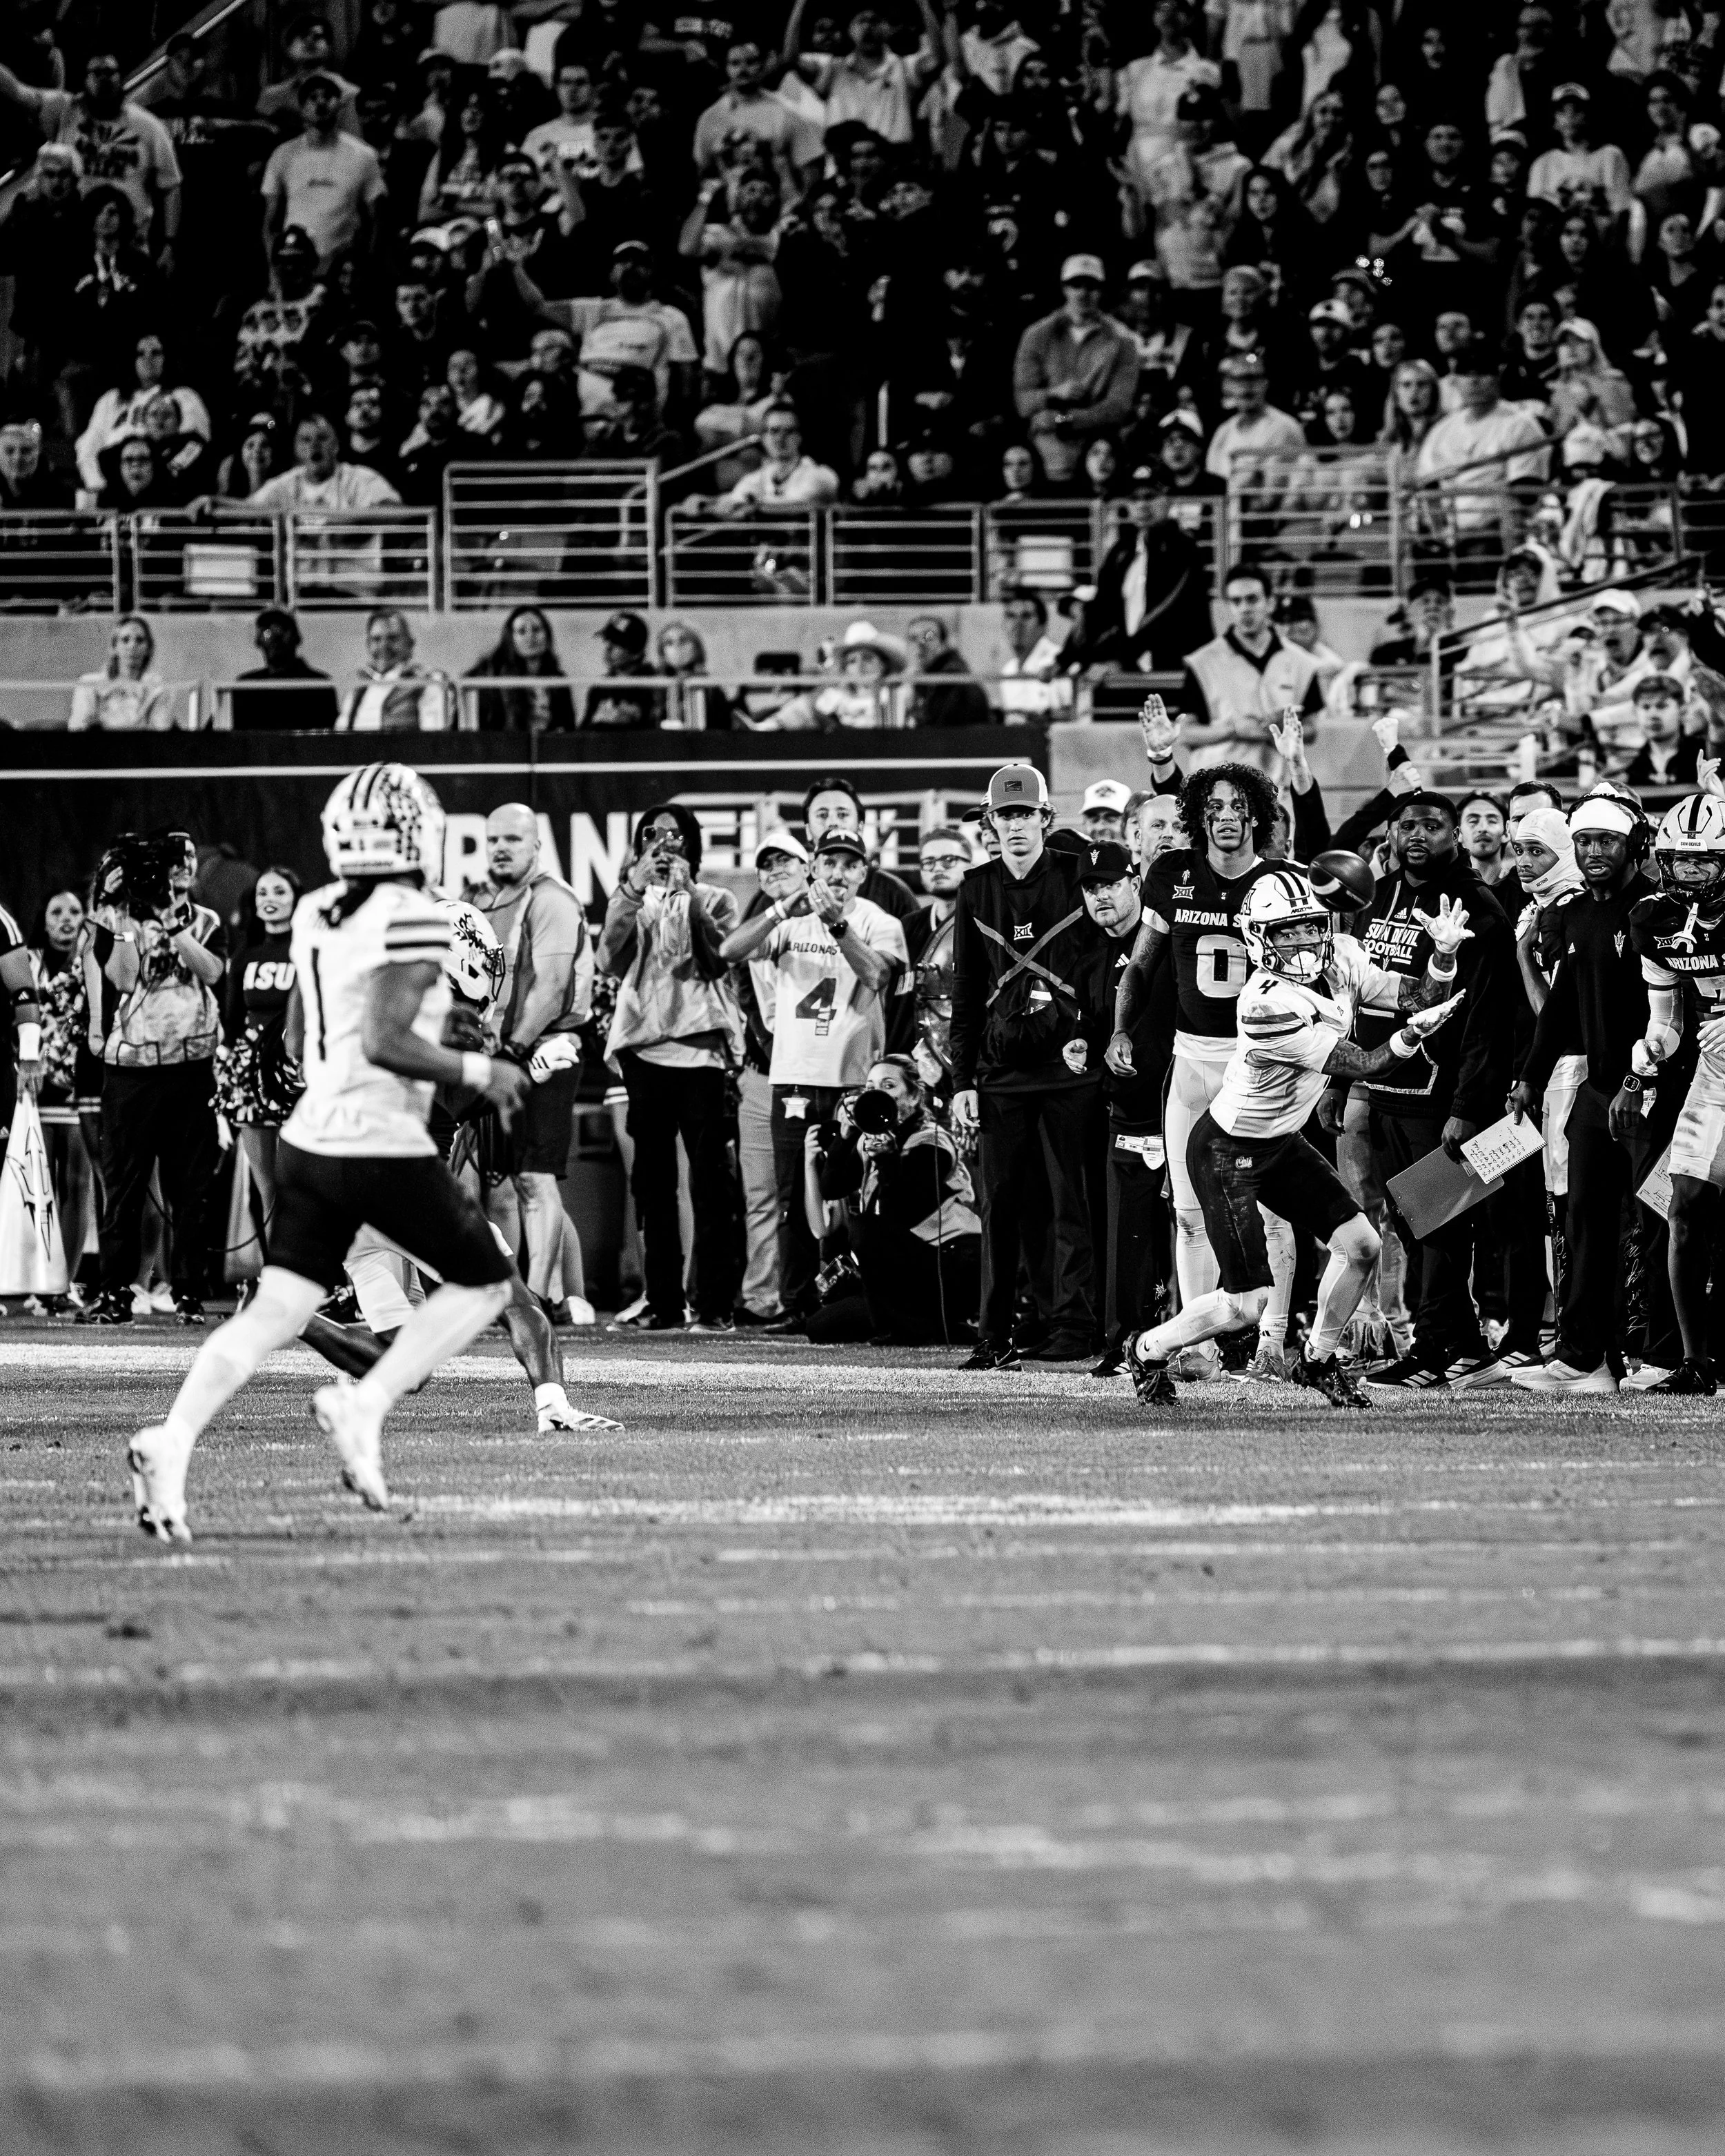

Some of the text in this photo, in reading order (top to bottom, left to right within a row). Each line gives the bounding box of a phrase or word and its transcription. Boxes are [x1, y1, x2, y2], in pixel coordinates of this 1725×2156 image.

[1174, 909, 1228, 927] ARIZONA
[1366, 923, 1392, 942] SUN
[1362, 938, 1412, 960] FOOTBALL
[1196, 934, 1247, 998] 0
[1665, 954, 1719, 971] ARIZONA
[1259, 980, 1279, 995] 4
[311, 947, 326, 1063] 1
[795, 978, 838, 1020] 4
